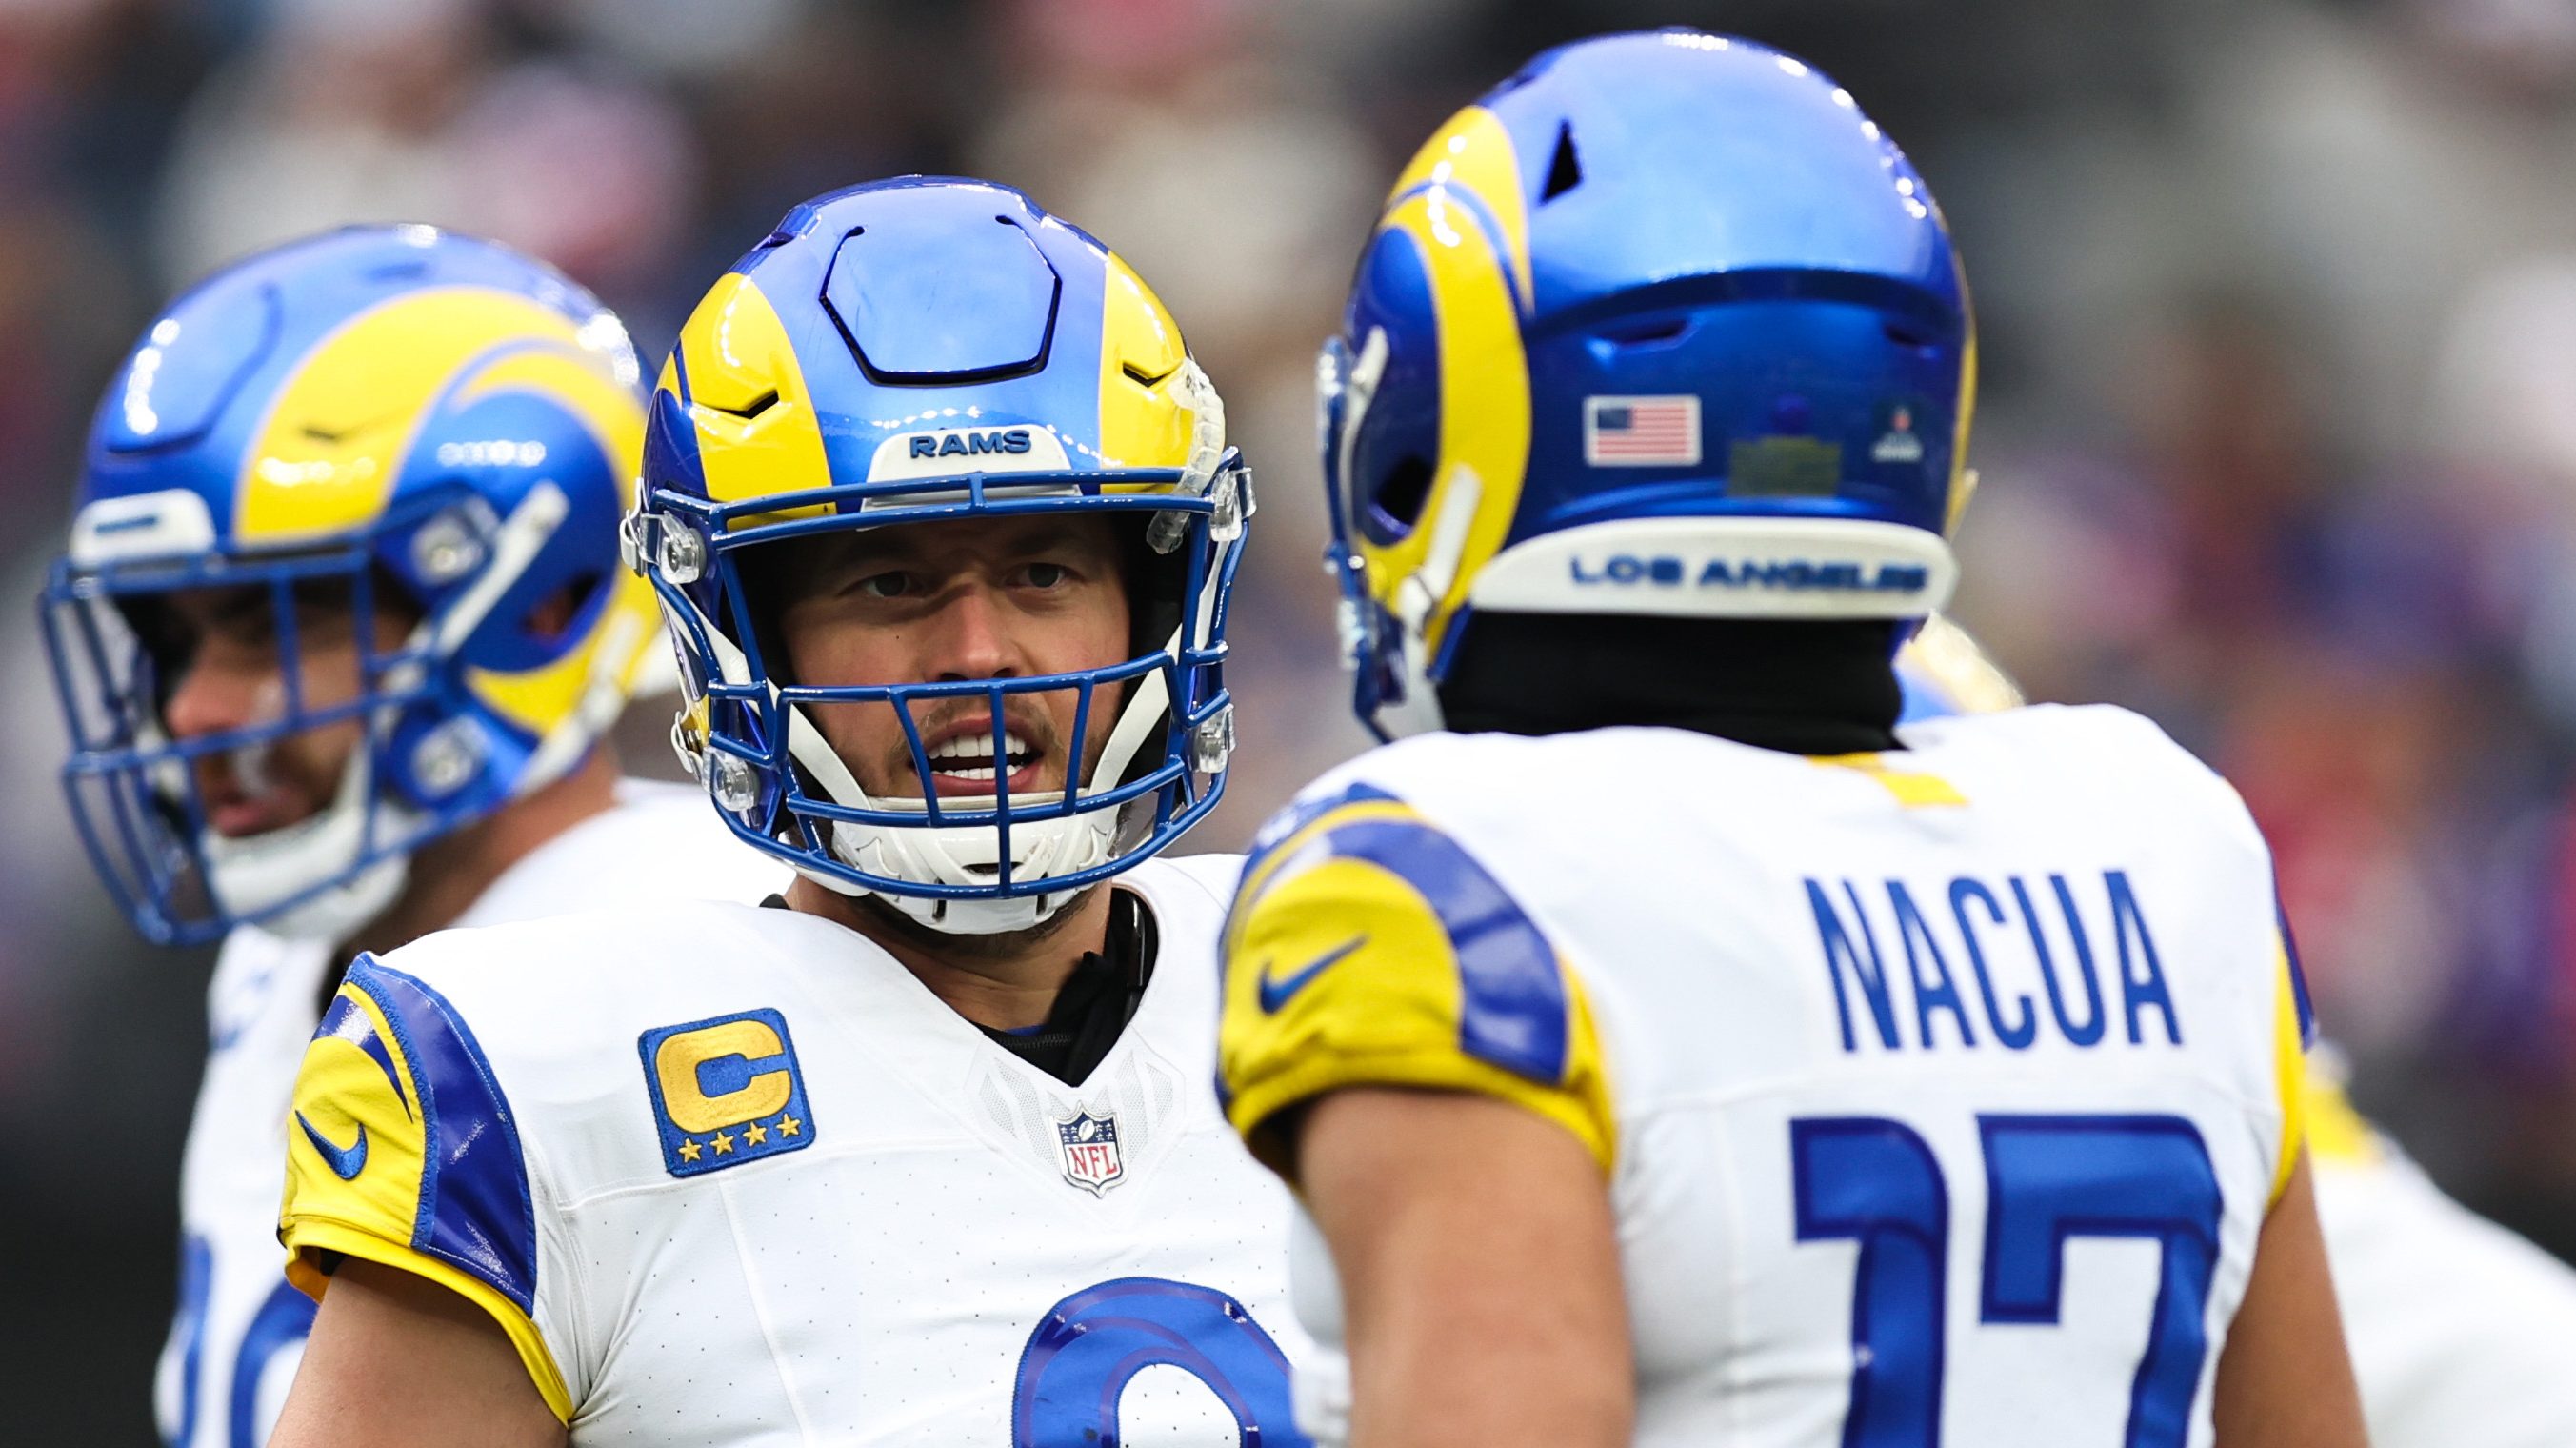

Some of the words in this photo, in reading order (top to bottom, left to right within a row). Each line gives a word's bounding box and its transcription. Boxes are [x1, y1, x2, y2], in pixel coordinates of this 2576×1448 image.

[909, 430, 1032, 458] RAMS
[1803, 870, 2183, 1052] NACUA
[655, 1019, 792, 1134] C
[1068, 1145, 1118, 1179] NFL
[1788, 1114, 2223, 1448] 17
